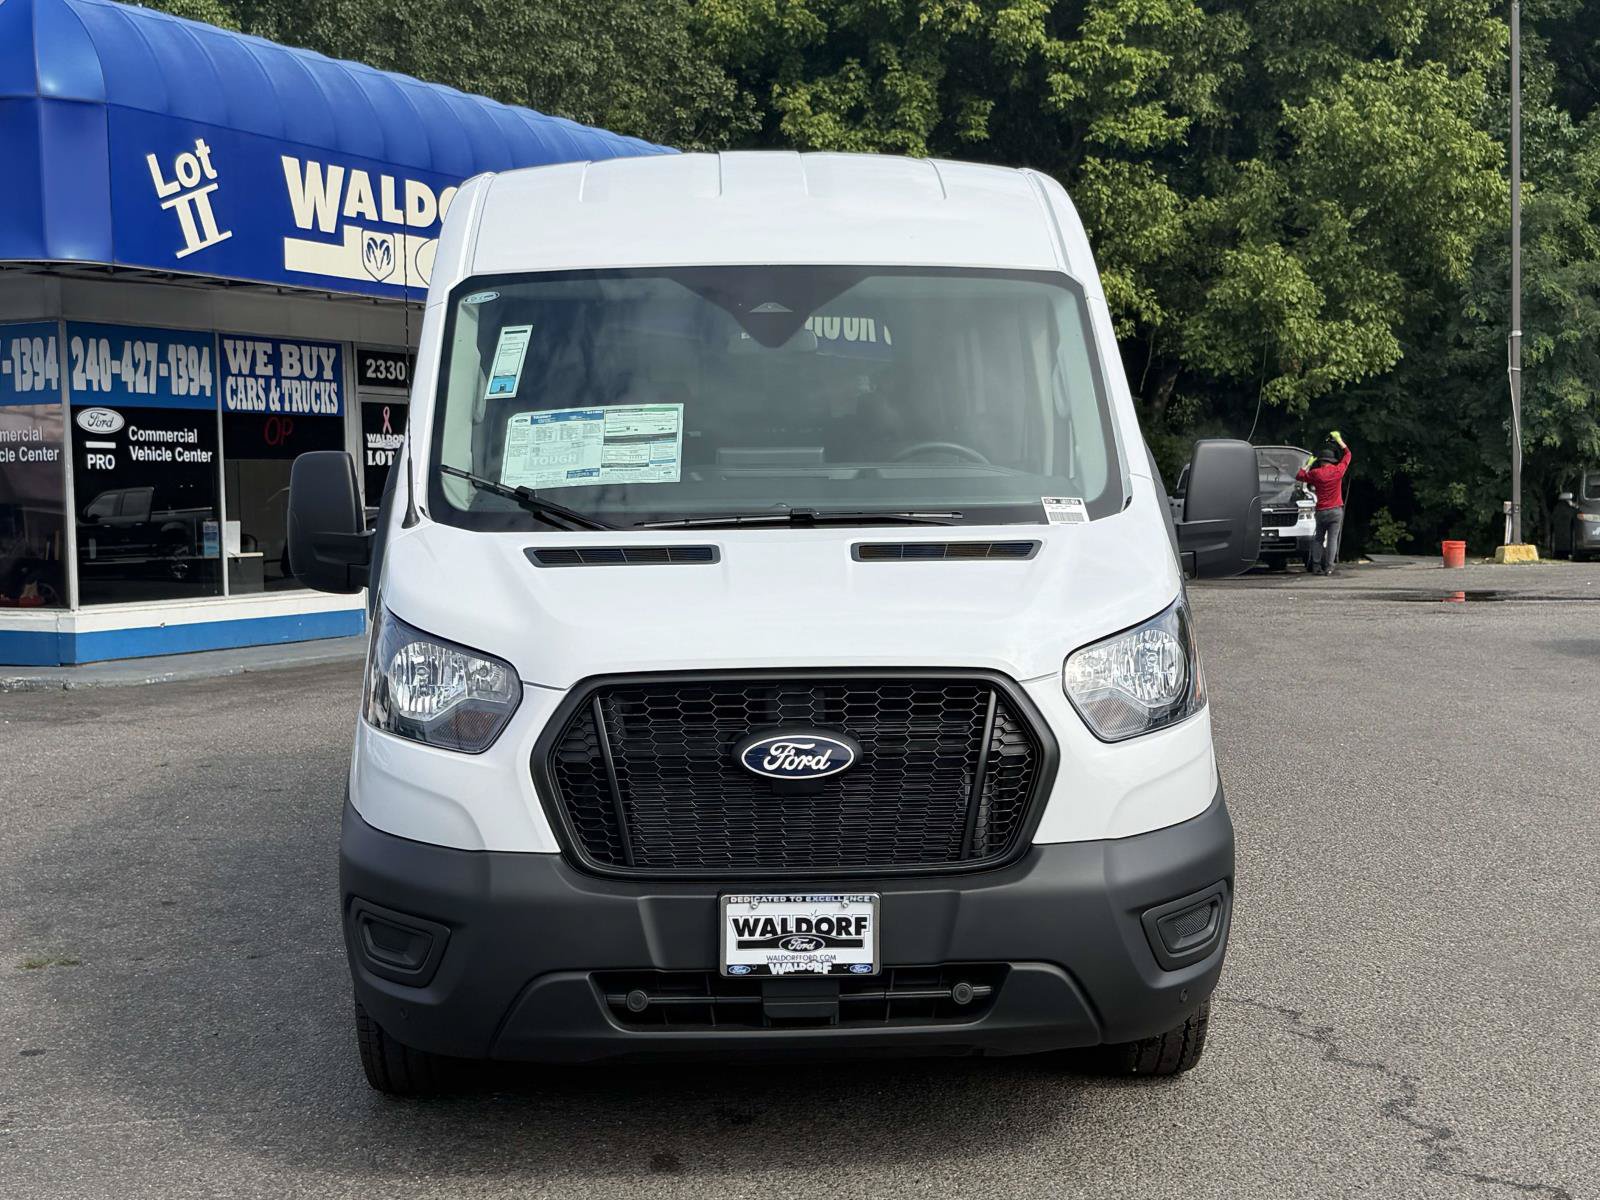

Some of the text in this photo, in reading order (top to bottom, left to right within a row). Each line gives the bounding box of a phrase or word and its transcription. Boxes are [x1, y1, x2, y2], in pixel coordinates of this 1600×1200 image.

[146, 138, 218, 199] Lot
[0, 336, 59, 392] -1394
[71, 336, 212, 397] 240-427-1394
[223, 339, 336, 380] WE BUY
[366, 358, 406, 380] 2330
[226, 376, 338, 414] CARS & TRUCKS
[87, 411, 114, 428] Ford
[128, 425, 198, 443] Commercial
[366, 433, 405, 443] WALDOR
[19, 446, 59, 462] Center
[86, 454, 116, 470] PRO
[129, 445, 213, 463] Vehicle Center
[367, 450, 395, 466] LOT
[763, 742, 832, 770] Ford
[730, 895, 870, 903] DEDICATED TO EXCELLENCE
[732, 916, 868, 938] WALDORF
[788, 938, 816, 951] Ford
[768, 961, 832, 975] WALDORF
